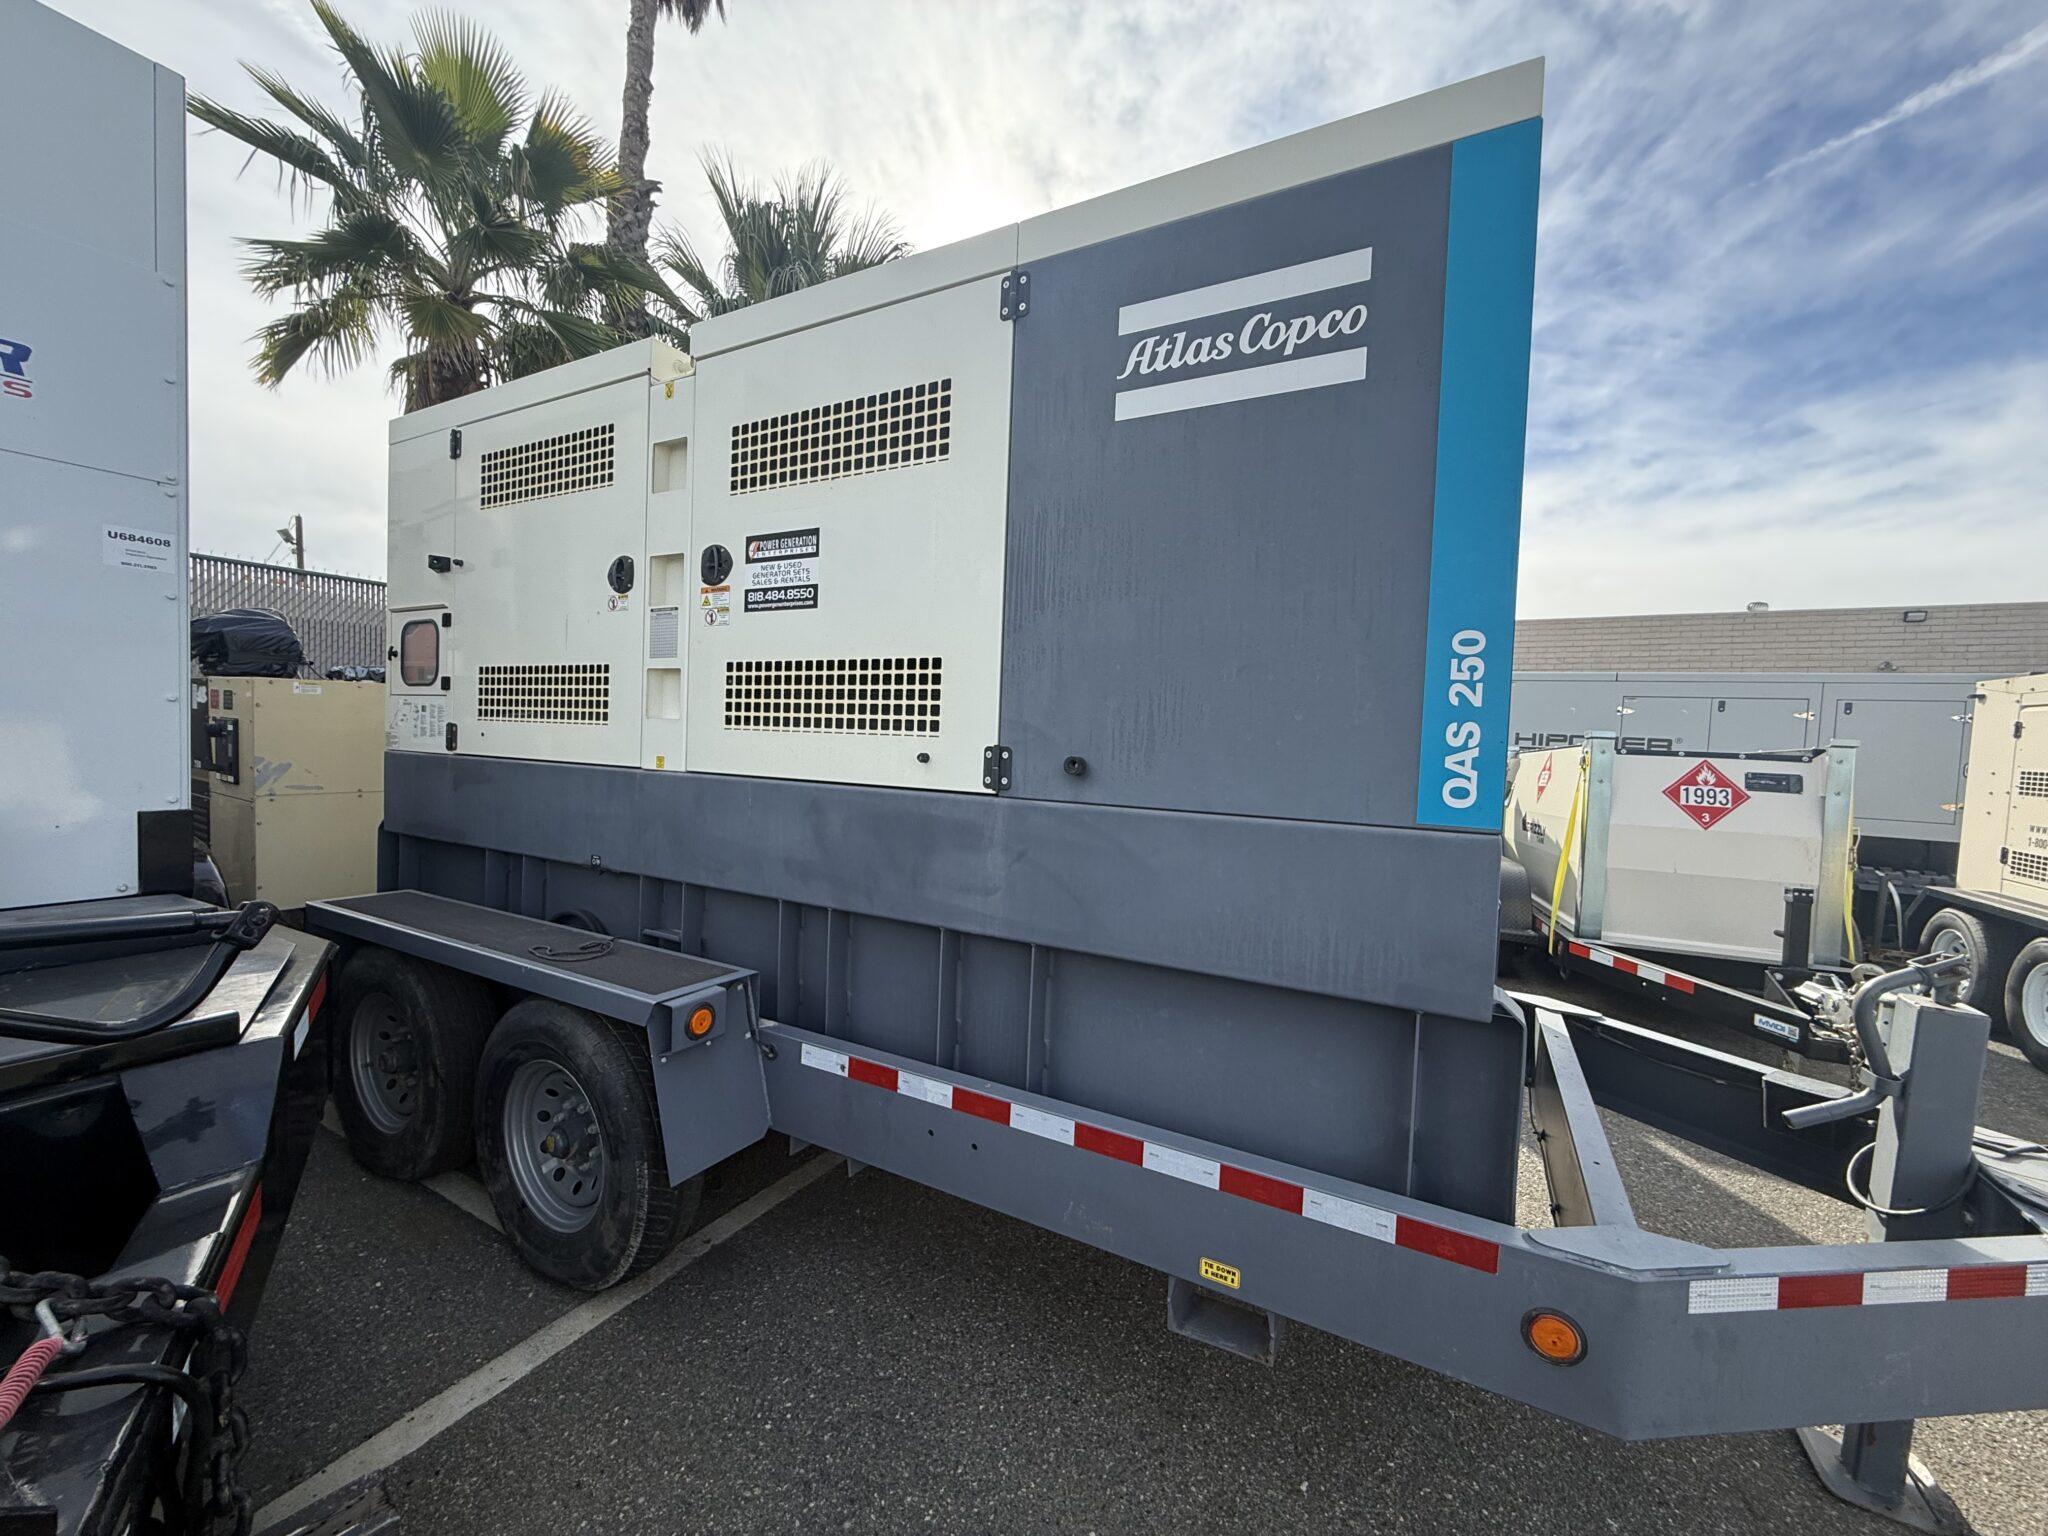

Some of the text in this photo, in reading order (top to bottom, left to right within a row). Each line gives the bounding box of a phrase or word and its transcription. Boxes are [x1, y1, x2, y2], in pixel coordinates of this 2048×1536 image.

[1117, 304, 1368, 380] Atlas Copco
[107, 530, 171, 548] U684608
[760, 534, 817, 552] POWER GENERATION
[752, 567, 810, 580] GENERATOR SETS
[761, 561, 802, 571] NEW & USED
[752, 579, 772, 587] SALES
[781, 575, 811, 584] RENTALS
[747, 587, 815, 603] 818.484.8550
[1442, 629, 1487, 809] QAS 250
[1682, 787, 1730, 807] 1993
[1701, 812, 1710, 823] 3
[1204, 1261, 1237, 1277] TIE DOWN
[1211, 1271, 1228, 1282] HERE
